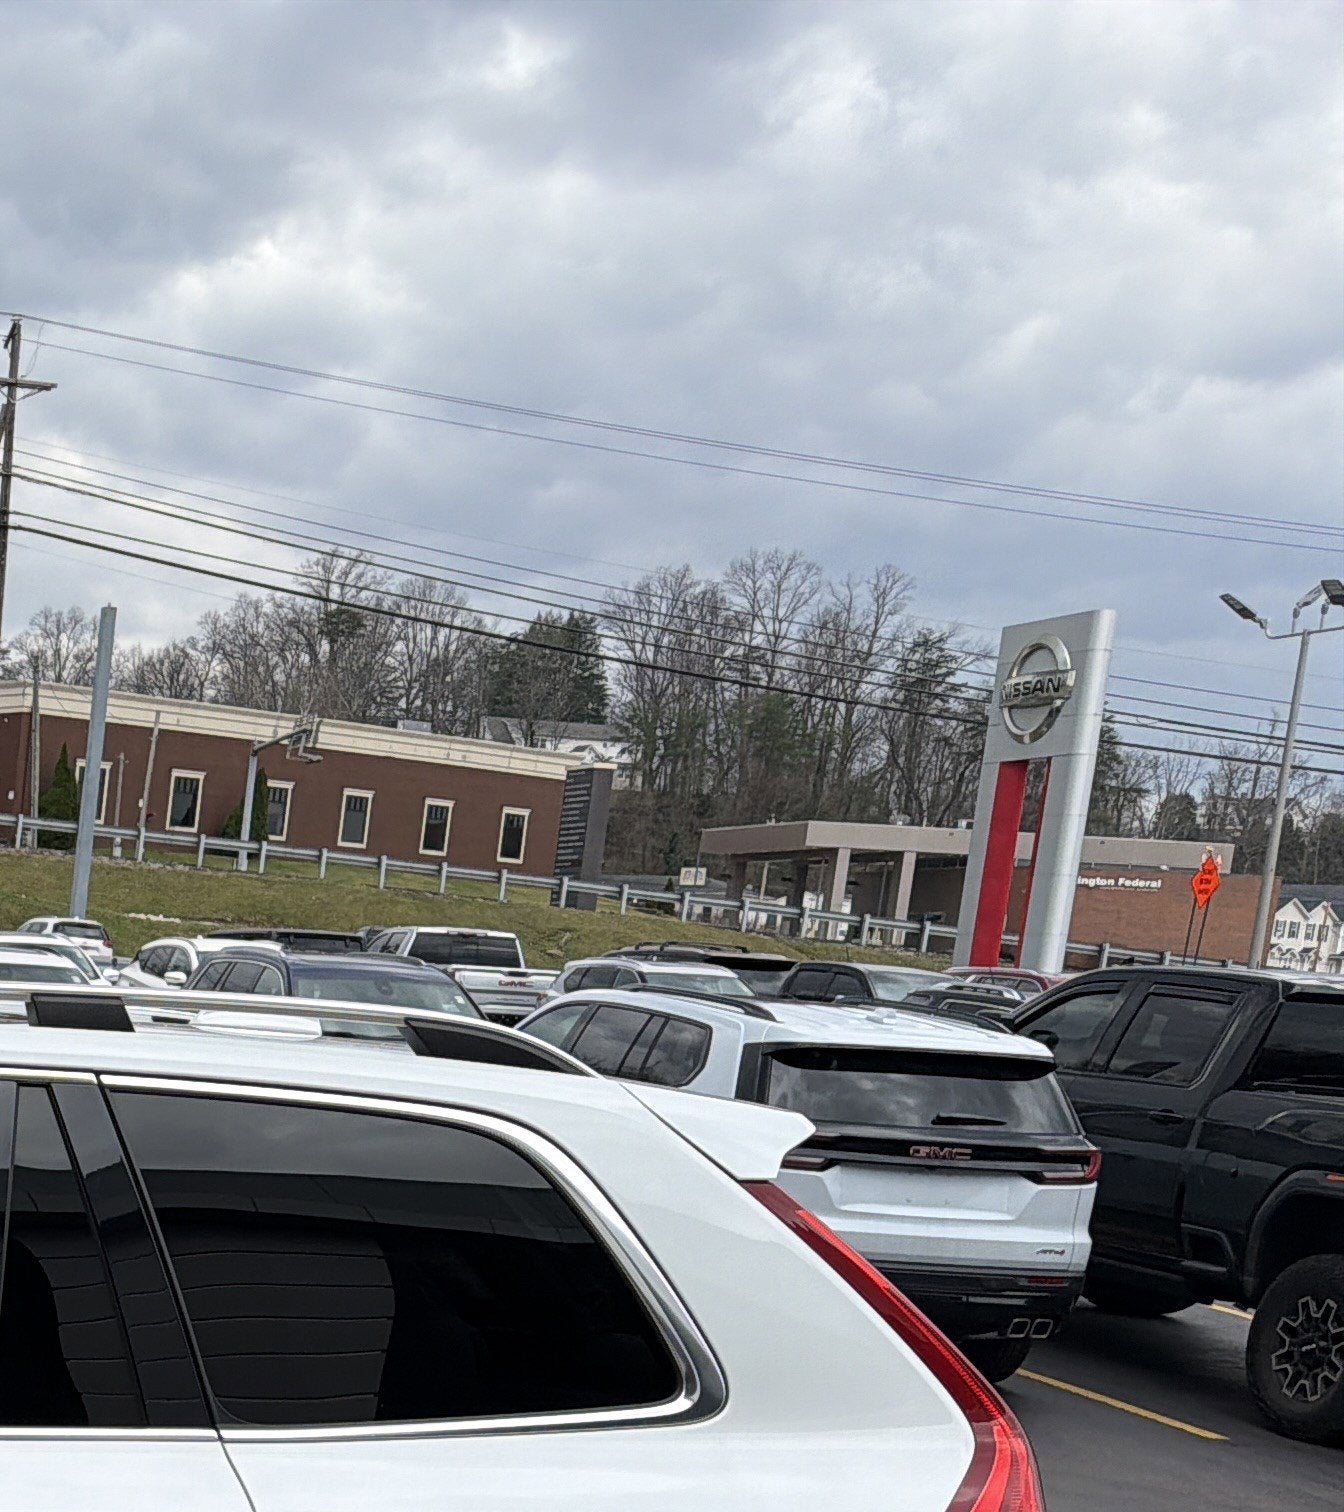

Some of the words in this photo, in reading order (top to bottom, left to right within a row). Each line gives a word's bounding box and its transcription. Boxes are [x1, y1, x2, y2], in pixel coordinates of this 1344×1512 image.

[1002, 677, 1062, 699] NISSAN
[1117, 877, 1162, 889] Federal
[909, 1145, 973, 1160] GMC
